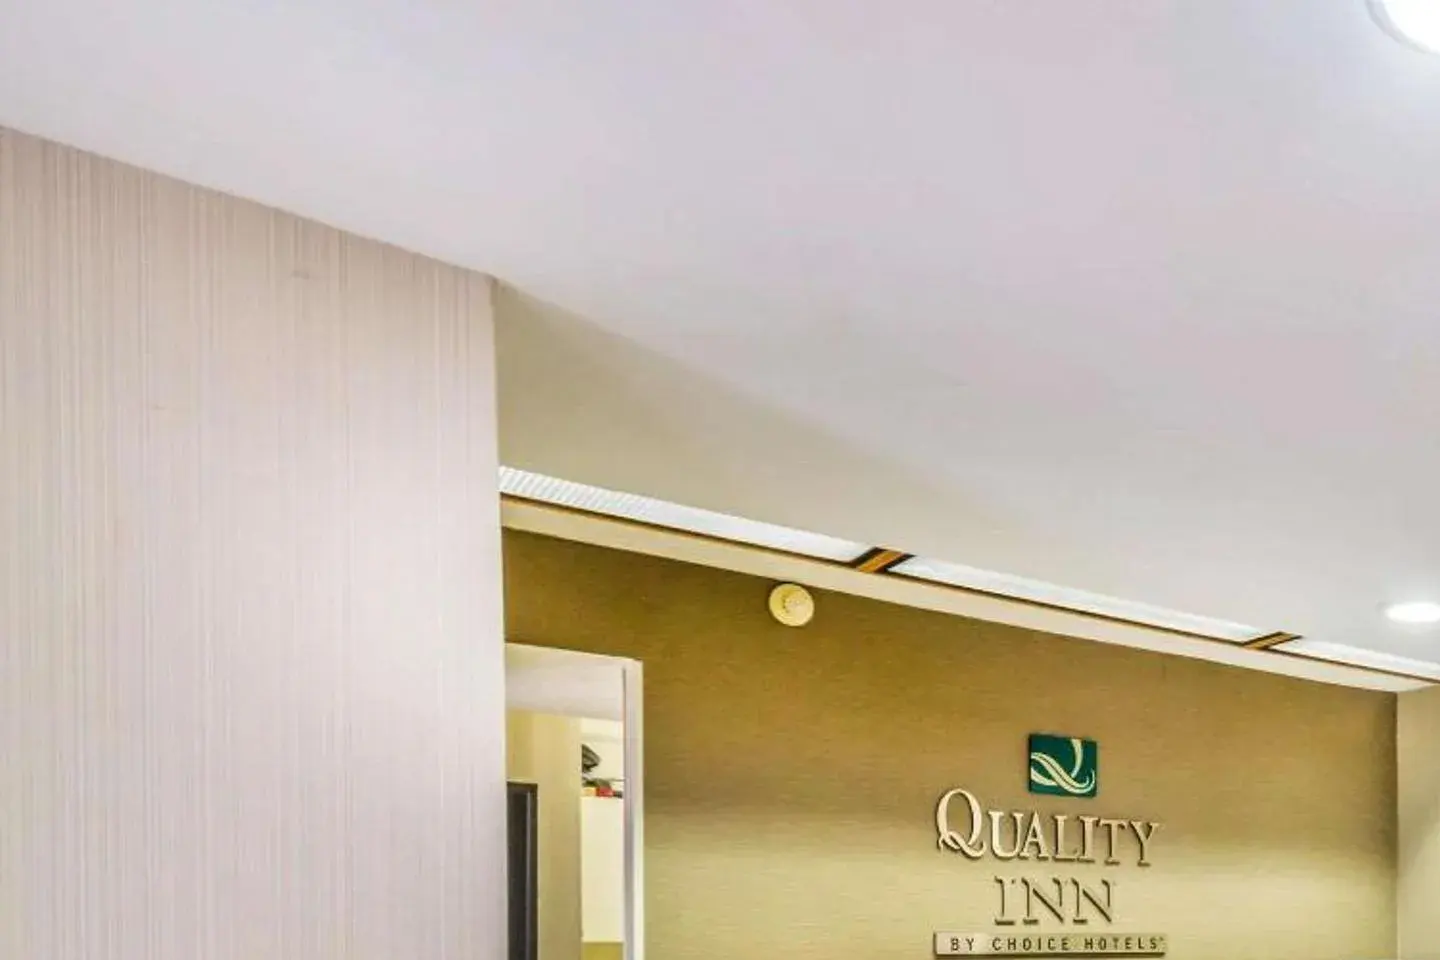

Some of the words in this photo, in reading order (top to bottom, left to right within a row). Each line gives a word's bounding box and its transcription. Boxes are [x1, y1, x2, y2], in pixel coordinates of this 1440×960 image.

[936, 788, 1159, 865] QUALITY
[994, 877, 1114, 925] INN
[950, 938, 976, 951] BY
[992, 937, 1069, 951] CHOICE
